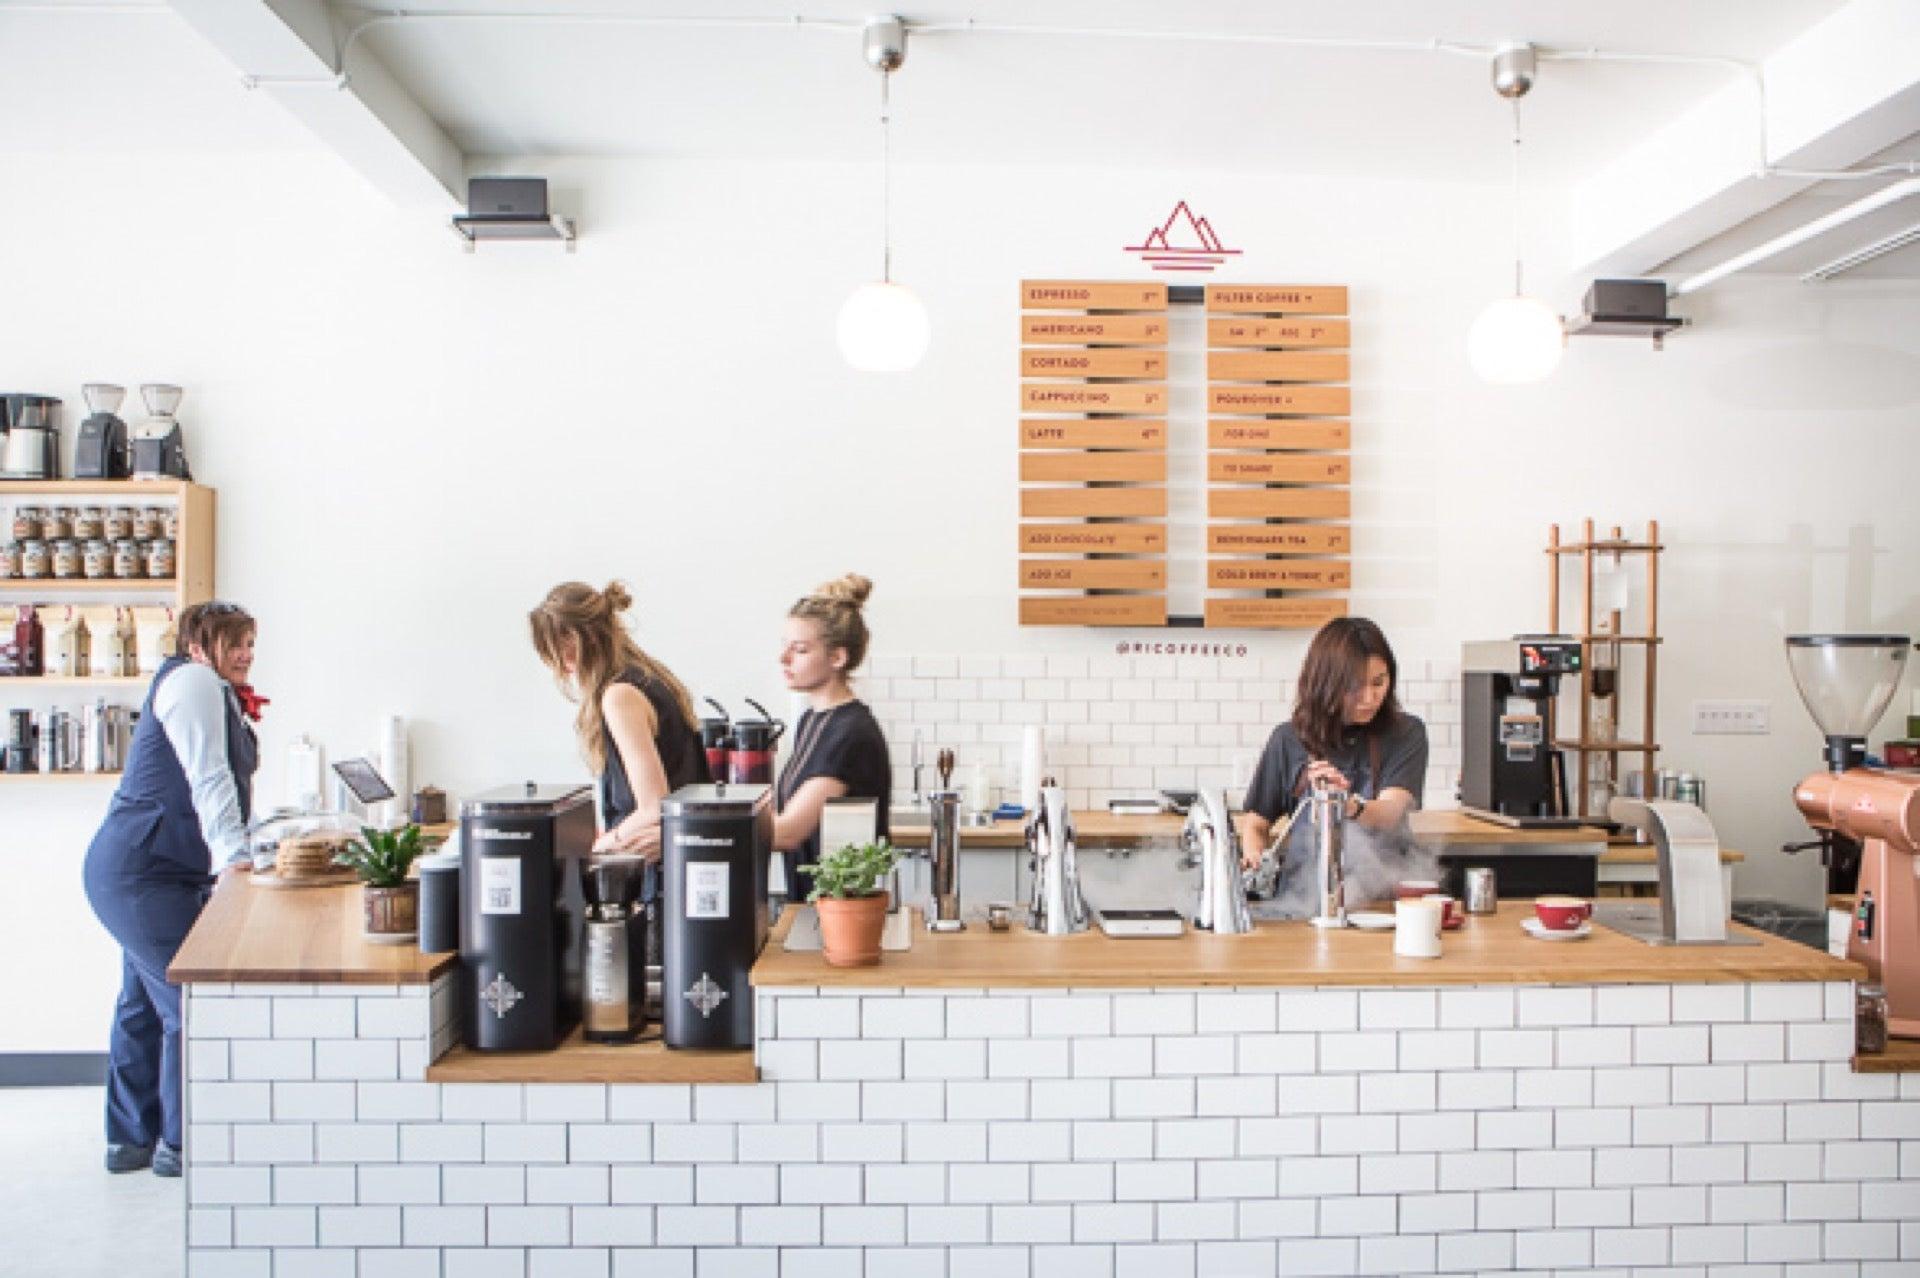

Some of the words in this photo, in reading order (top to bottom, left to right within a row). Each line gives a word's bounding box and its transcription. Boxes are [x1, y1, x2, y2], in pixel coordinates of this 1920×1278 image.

[1030, 289, 1090, 300] ESPRESSO
[1214, 292, 1253, 303] FILTER
[1256, 292, 1300, 303] COFFEE
[1030, 325, 1104, 336] AMERICANO
[1030, 358, 1090, 369] CORTADO
[1029, 390, 1110, 403] CAPPUCCINO
[1028, 429, 1064, 440] LATTE
[1028, 534, 1051, 544] ADD
[1054, 534, 1116, 545] CHOCOLATE
[1288, 535, 1306, 545] TEA
[1028, 570, 1051, 580] ADD
[1054, 570, 1071, 580] ICE
[1216, 569, 1247, 580] COLD
[1249, 570, 1276, 580] BREW
[1115, 641, 1248, 657] @RICOFFEECO
